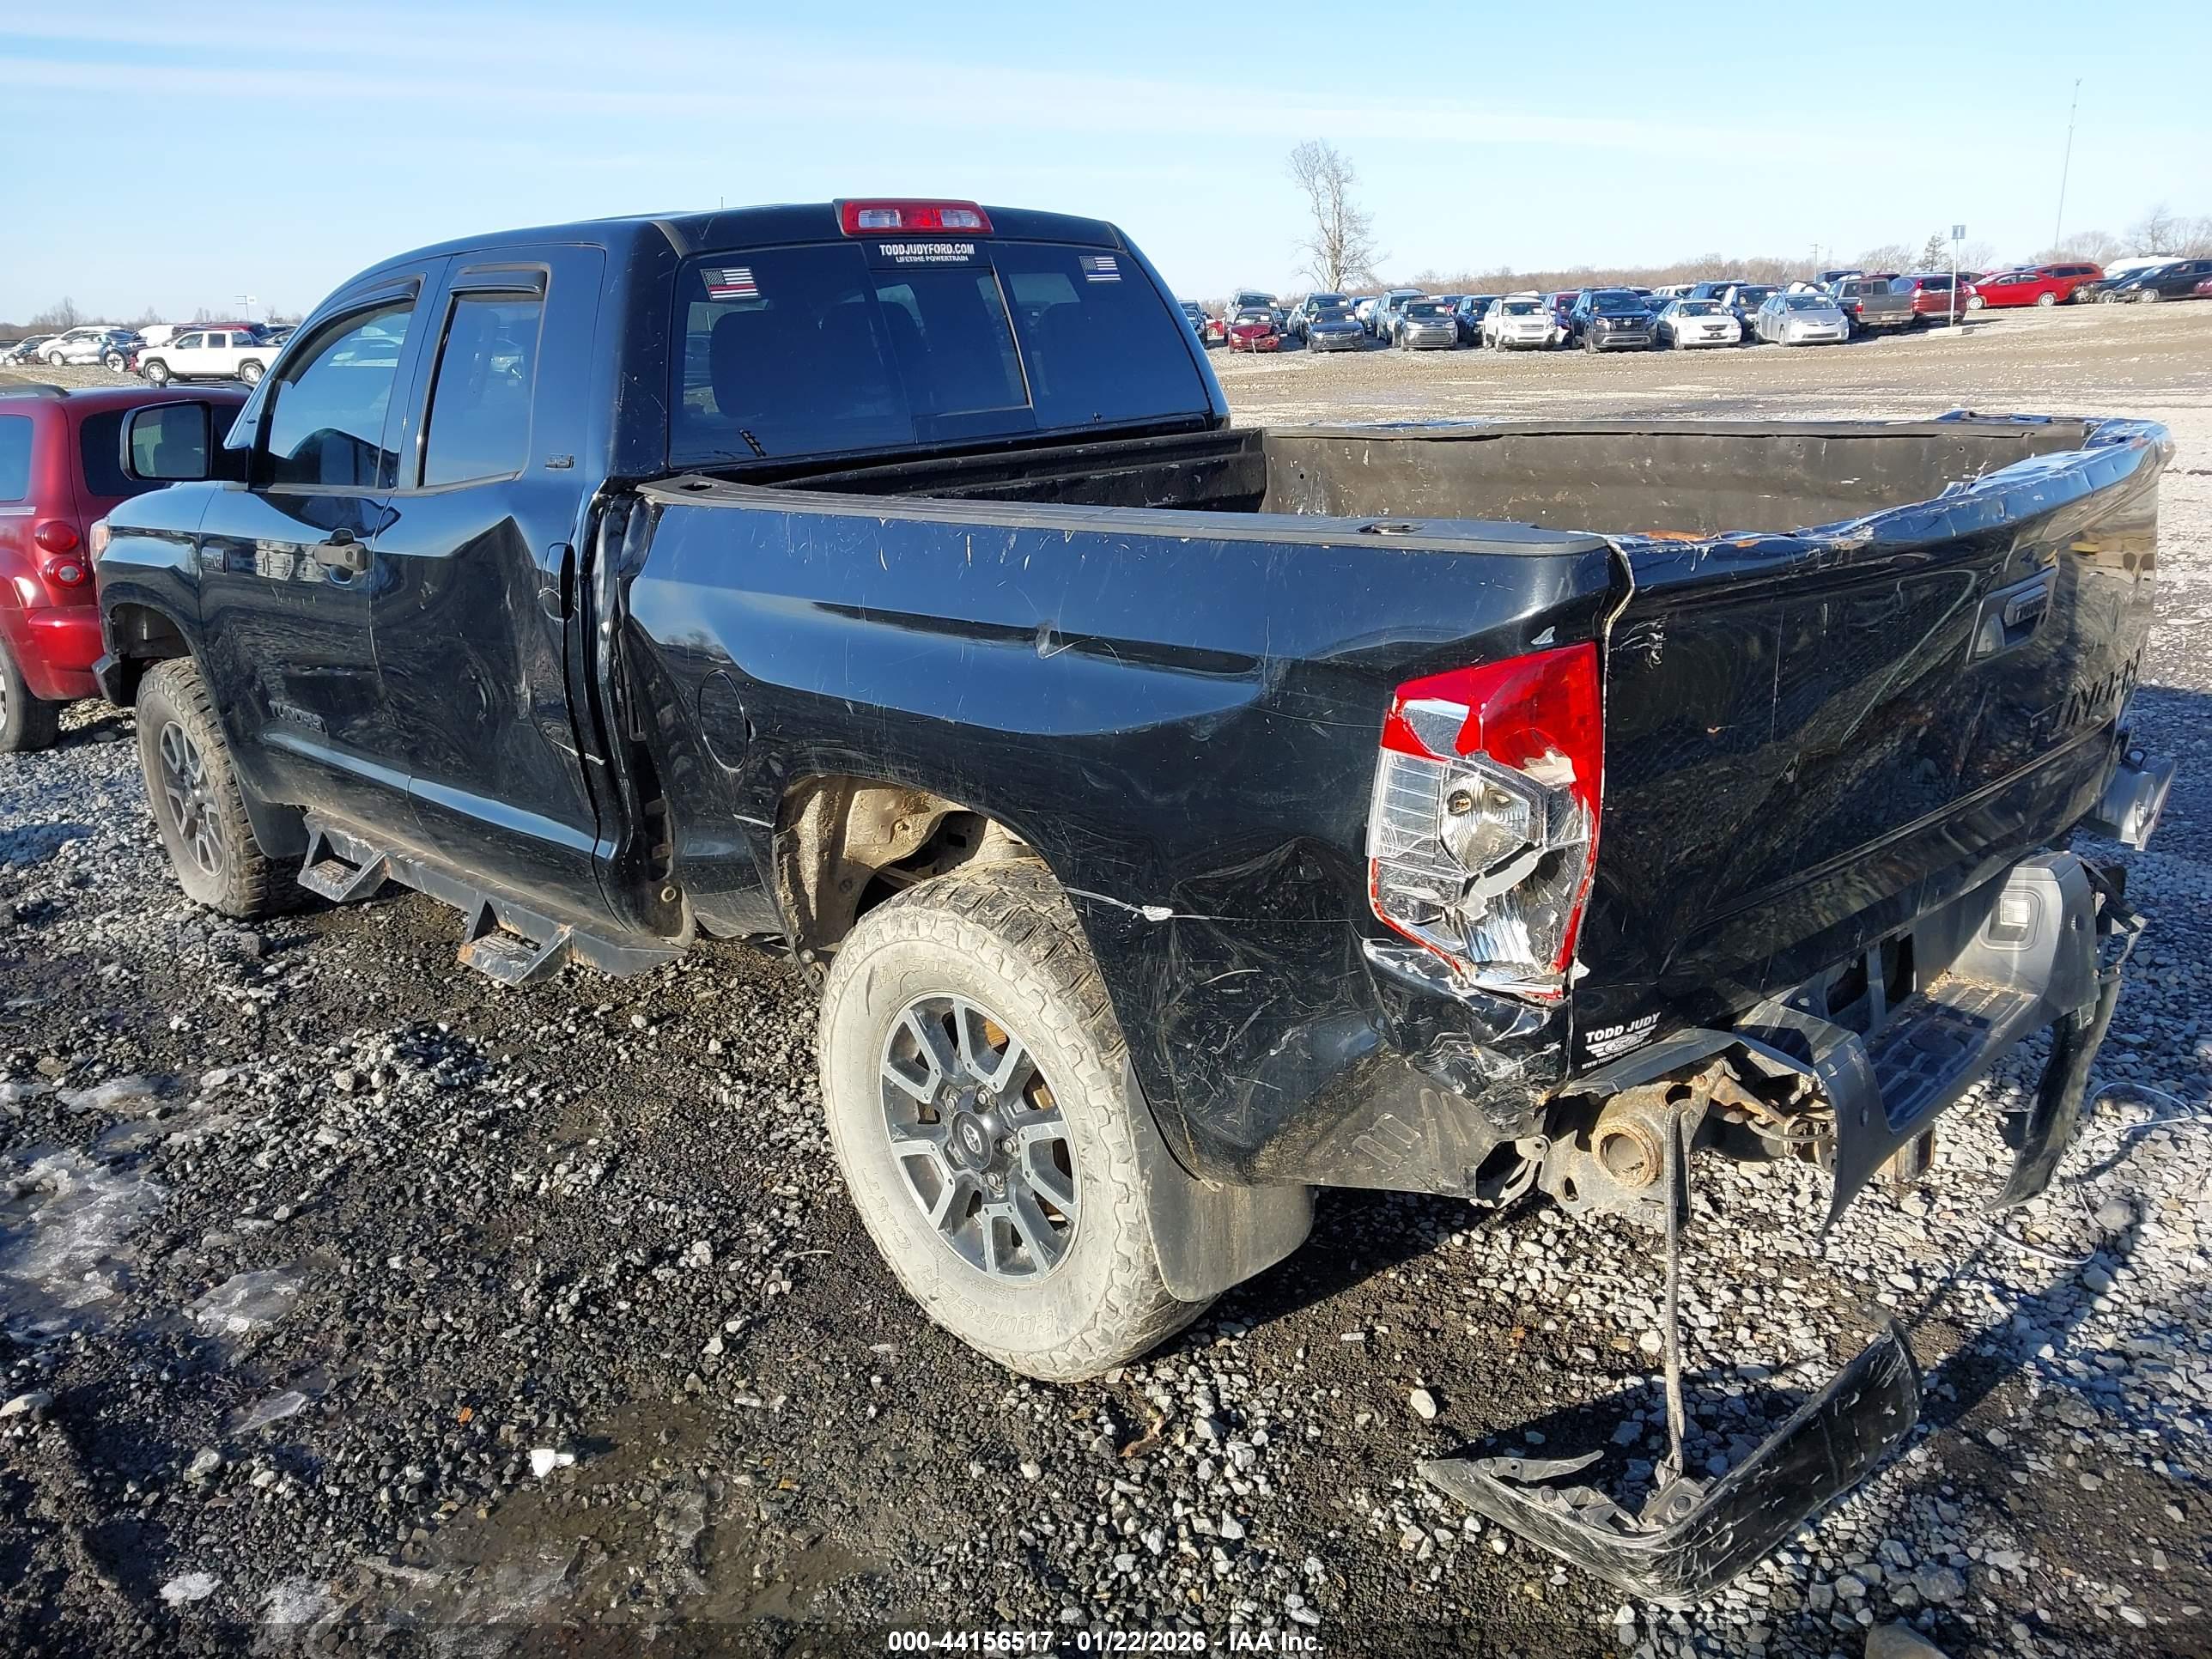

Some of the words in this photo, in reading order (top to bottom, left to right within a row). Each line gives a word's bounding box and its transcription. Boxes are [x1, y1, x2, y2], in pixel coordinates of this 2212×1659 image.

[878, 243, 975, 257] TODDJUDYFORD.COM
[1585, 1024, 1625, 1043] TODD
[1626, 1012, 1662, 1033] JUDY
